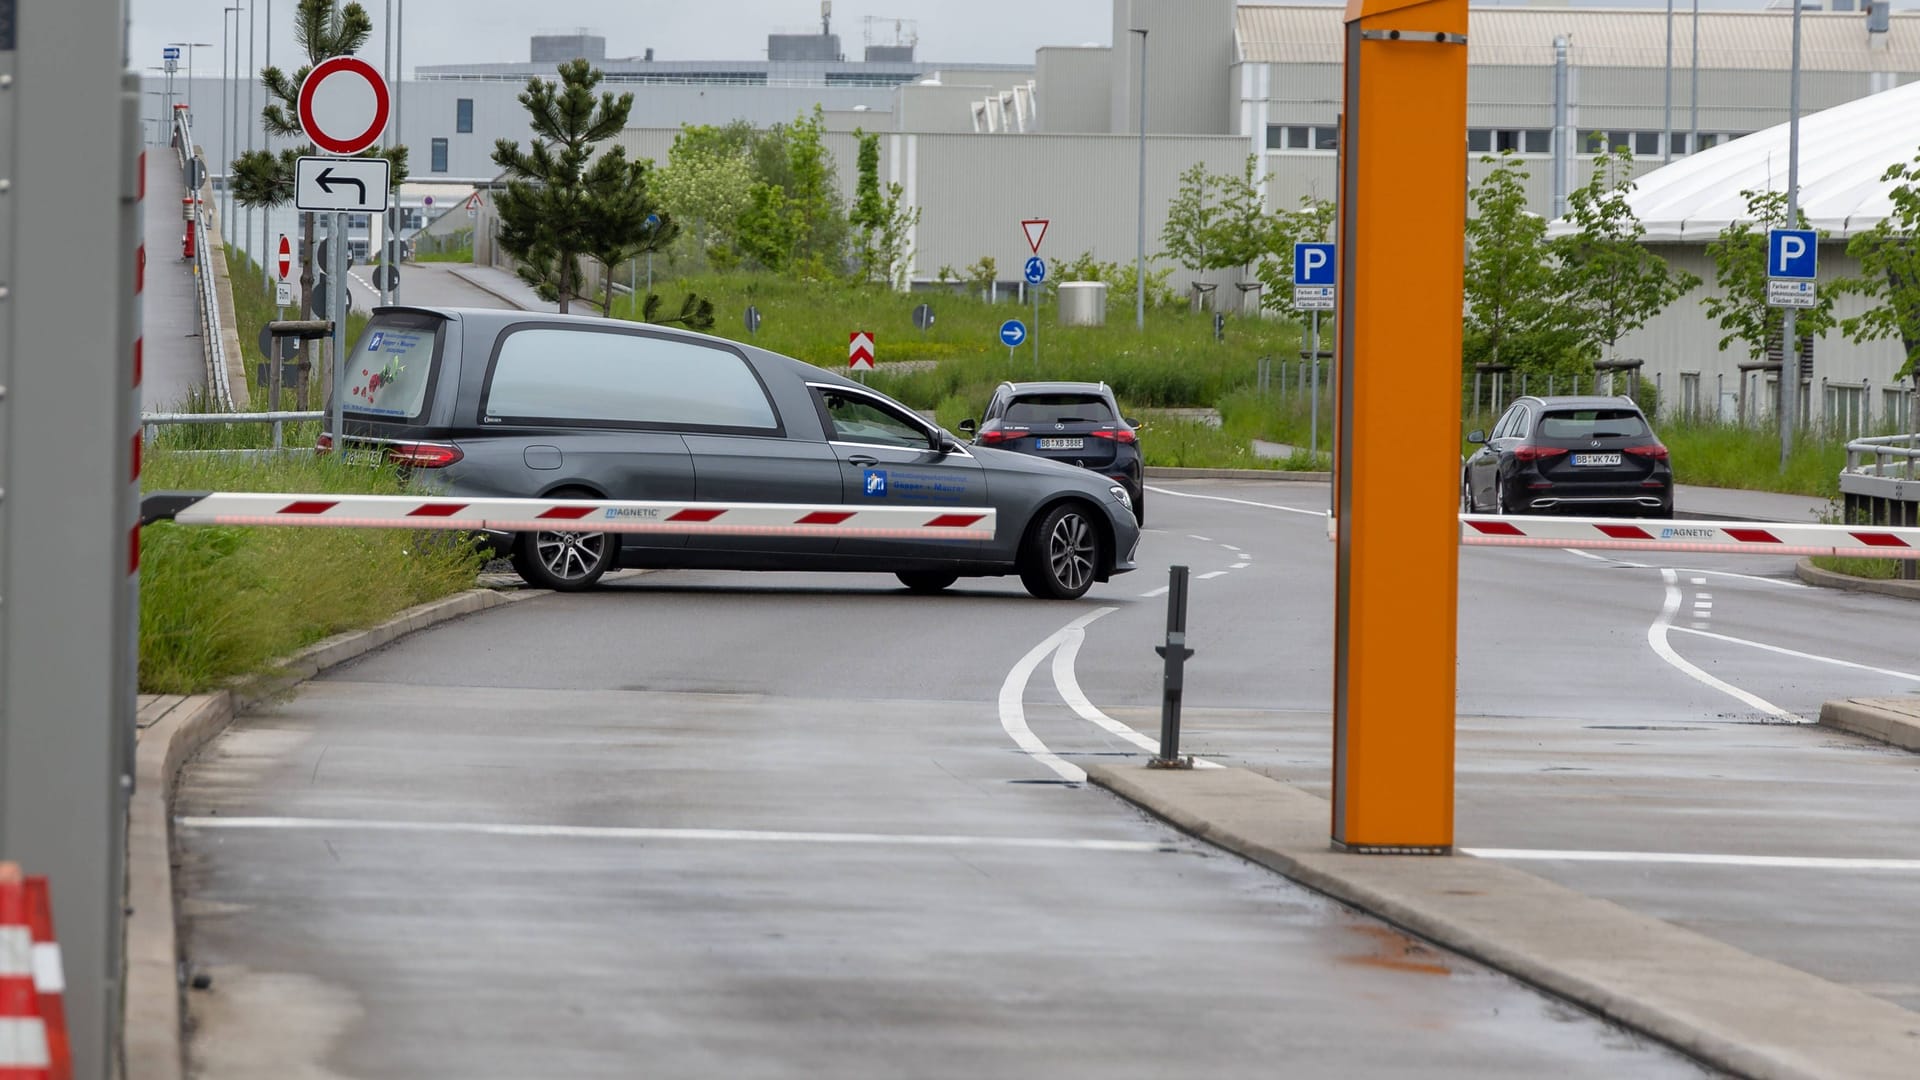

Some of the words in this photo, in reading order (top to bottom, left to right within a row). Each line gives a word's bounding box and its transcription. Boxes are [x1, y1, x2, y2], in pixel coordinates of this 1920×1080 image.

[1780, 235, 1806, 272] P
[1304, 248, 1327, 280] P
[1041, 439, 1051, 447] BB
[1576, 455, 1587, 463] BB
[1592, 455, 1603, 463] WK
[1604, 455, 1620, 463] 747
